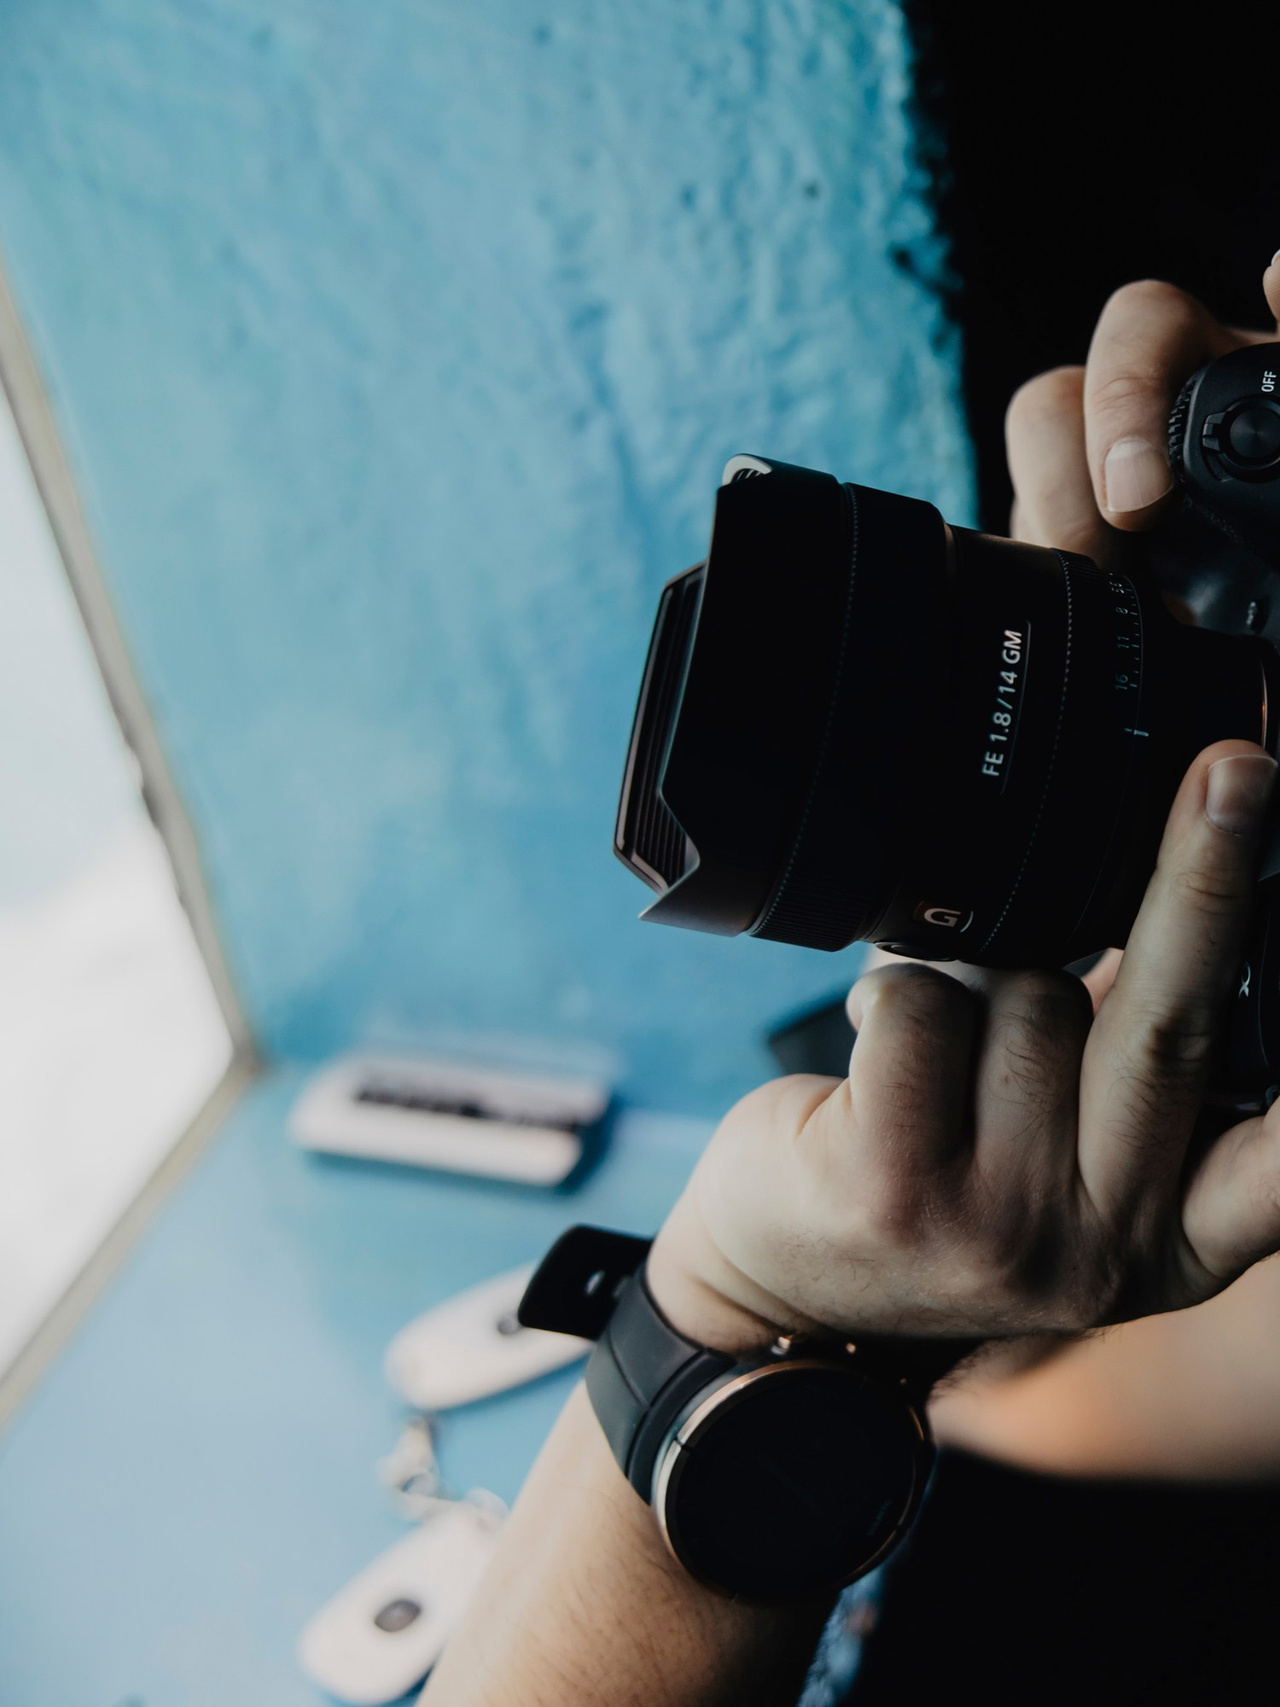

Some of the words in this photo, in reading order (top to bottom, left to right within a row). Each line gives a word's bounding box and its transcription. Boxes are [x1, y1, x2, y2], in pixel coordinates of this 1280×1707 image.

[1260, 370, 1277, 392] OFF
[1001, 629, 1023, 665] GM
[1113, 672, 1129, 691] 16
[988, 670, 1018, 742] 1.8/14
[981, 750, 1005, 777] FE
[923, 906, 962, 928] G
